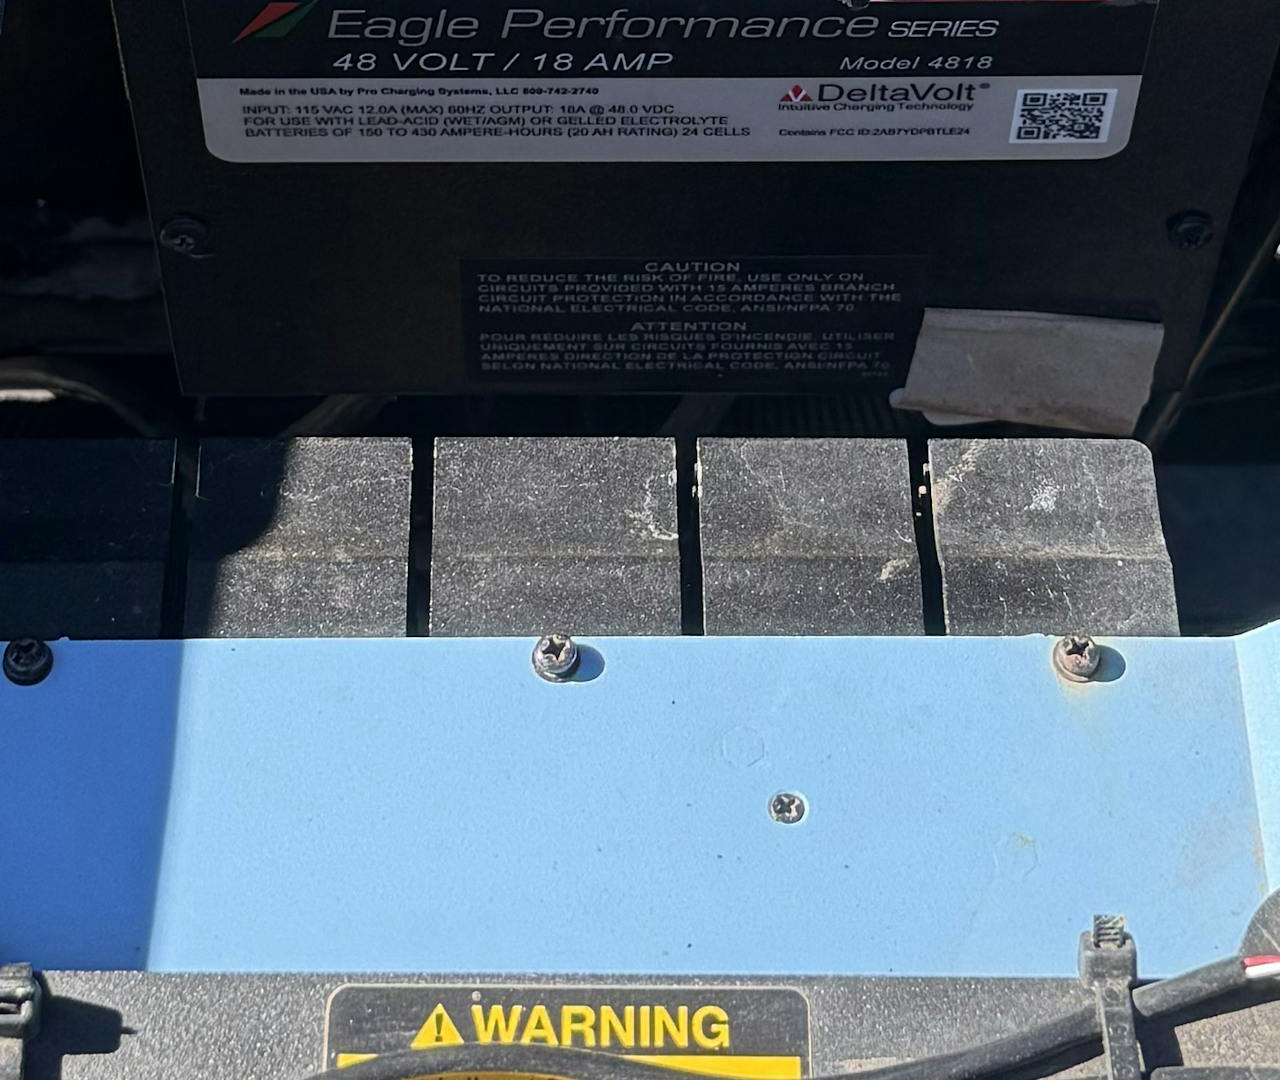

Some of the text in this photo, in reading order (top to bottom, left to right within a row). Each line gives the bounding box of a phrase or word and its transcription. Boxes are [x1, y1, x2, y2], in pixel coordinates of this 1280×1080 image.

[328, 9, 998, 46] Eagle Performance SERIES
[333, 53, 673, 71] 48 VOLT / 18 AMP
[840, 56, 993, 70] Model 4818
[238, 87, 271, 95] Made
[273, 87, 285, 95] in
[287, 87, 307, 95] the
[309, 87, 337, 95] USA
[338, 87, 354, 96] by
[356, 87, 378, 95] Pro
[380, 87, 435, 96] Charging
[437, 87, 492, 96] Systems,
[494, 87, 518, 95] LLC
[242, 105, 290, 114] INPUT:
[294, 105, 319, 114] 115
[320, 105, 353, 114] VAC
[357, 105, 398, 114] 12.0A
[400, 105, 444, 115] (MAX)
[447, 105, 485, 114] 60HZ
[588, 105, 604, 115] @
[641, 105, 674, 114] VDC
[776, 102, 974, 112] Intuitive Charging Technology
[242, 116, 276, 126] FOR
[278, 116, 312, 126] USE
[313, 116, 354, 125] WITH
[442, 116, 525, 126] (WET/AGM)
[529, 116, 552, 125] OR
[556, 116, 616, 125] GELLED
[620, 116, 728, 125] ELECTROLYTE
[644, 262, 740, 272] CAUTION
[476, 273, 502, 282] TO
[505, 273, 578, 282] REDUCE
[583, 273, 617, 282] THE
[622, 273, 664, 282] RISK
[666, 273, 692, 282] OF
[747, 273, 781, 282] USE
[786, 273, 833, 282] ONLY
[838, 272, 863, 281] ON
[630, 321, 749, 331] ATTENTION
[472, 1004, 730, 1048] WARNING
